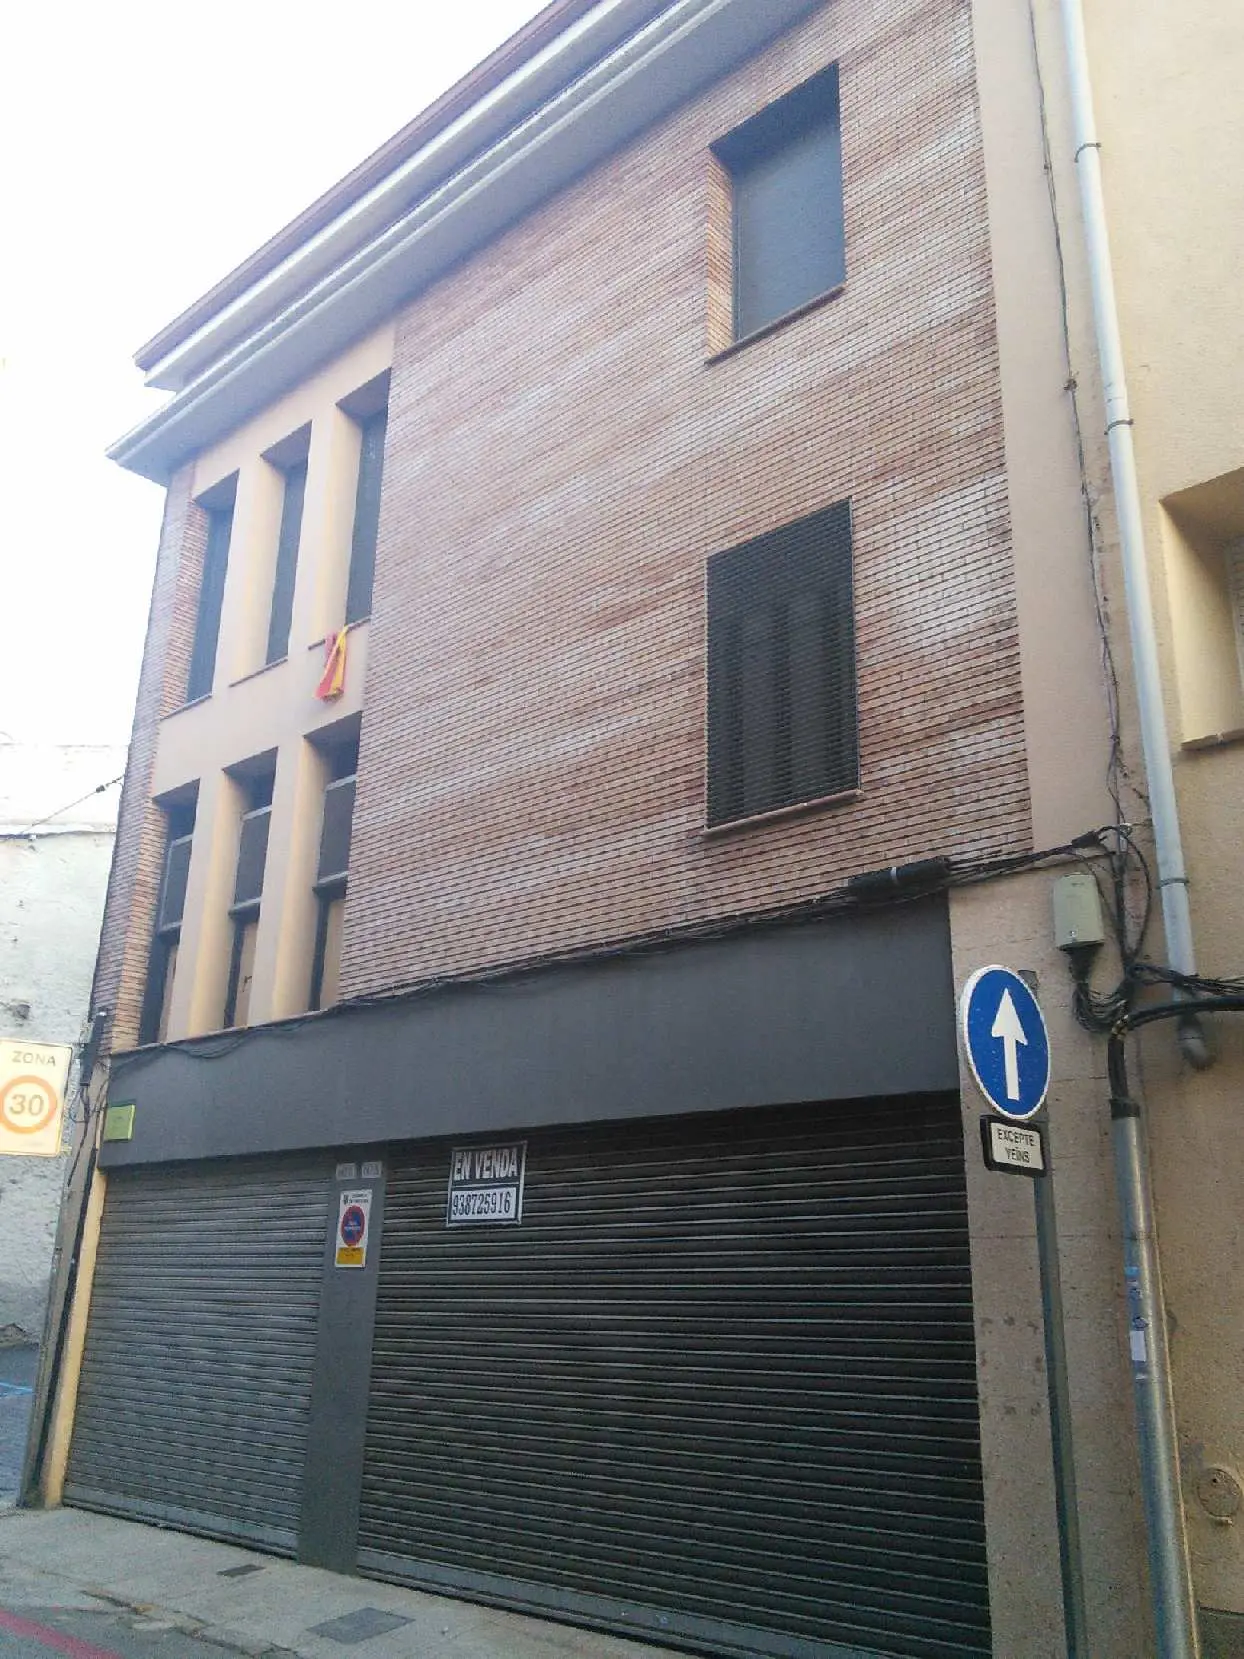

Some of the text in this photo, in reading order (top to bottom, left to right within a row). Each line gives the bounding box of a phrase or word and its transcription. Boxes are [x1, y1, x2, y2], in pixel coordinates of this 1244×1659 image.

[11, 1050, 56, 1067] ZONA
[9, 1093, 45, 1116] 30
[996, 1128, 1034, 1147] EXCEPTE
[453, 1147, 518, 1180] EN VENDA
[452, 1191, 512, 1216] 938725916
